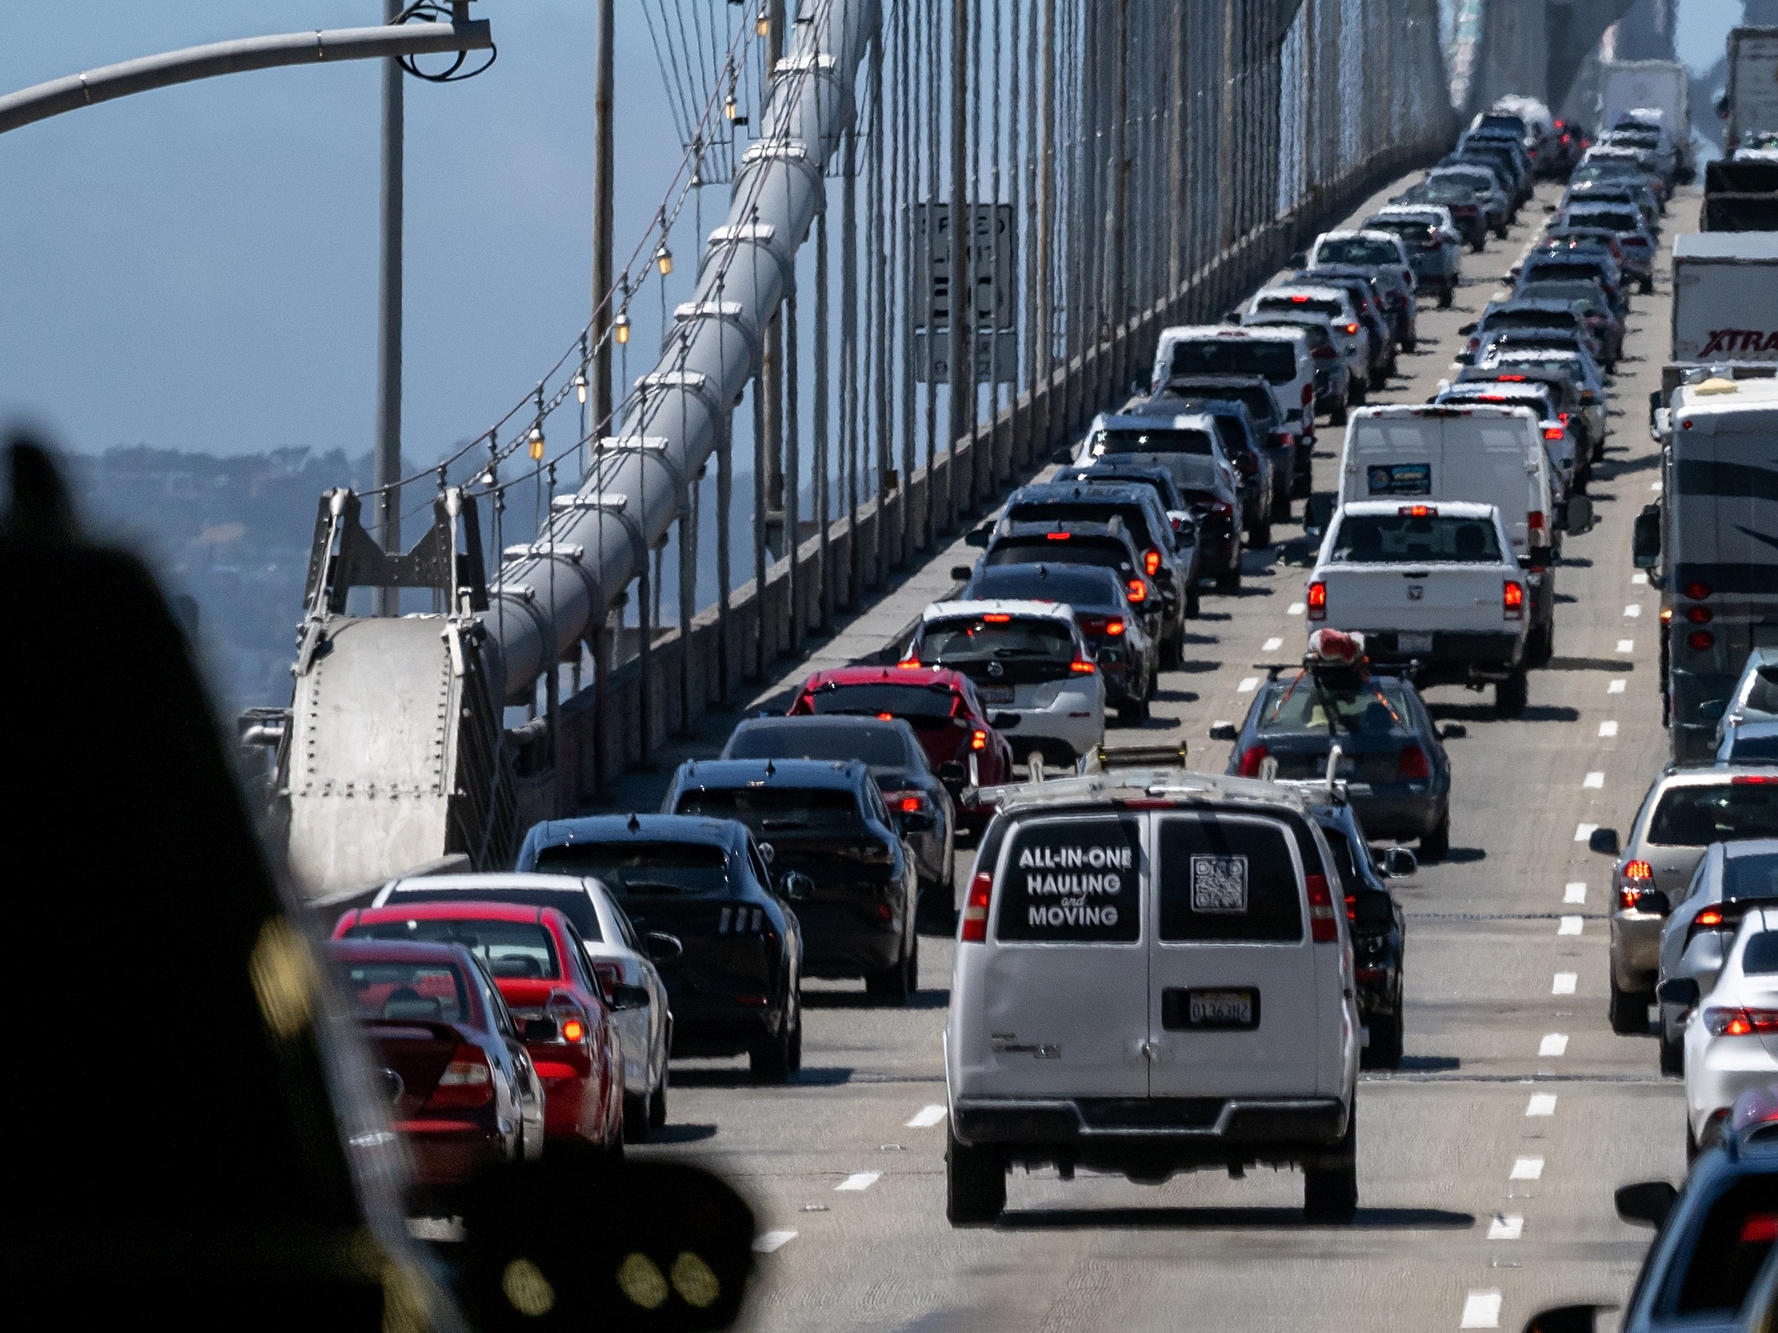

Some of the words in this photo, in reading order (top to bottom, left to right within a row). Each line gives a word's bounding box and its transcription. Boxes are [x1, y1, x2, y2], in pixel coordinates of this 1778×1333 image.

[921, 216, 1006, 236] PED
[1018, 846, 1132, 869] ALL-IN-ONE
[1027, 872, 1121, 896] HAULING
[1060, 893, 1086, 907] and
[1028, 904, 1119, 927] MOVING
